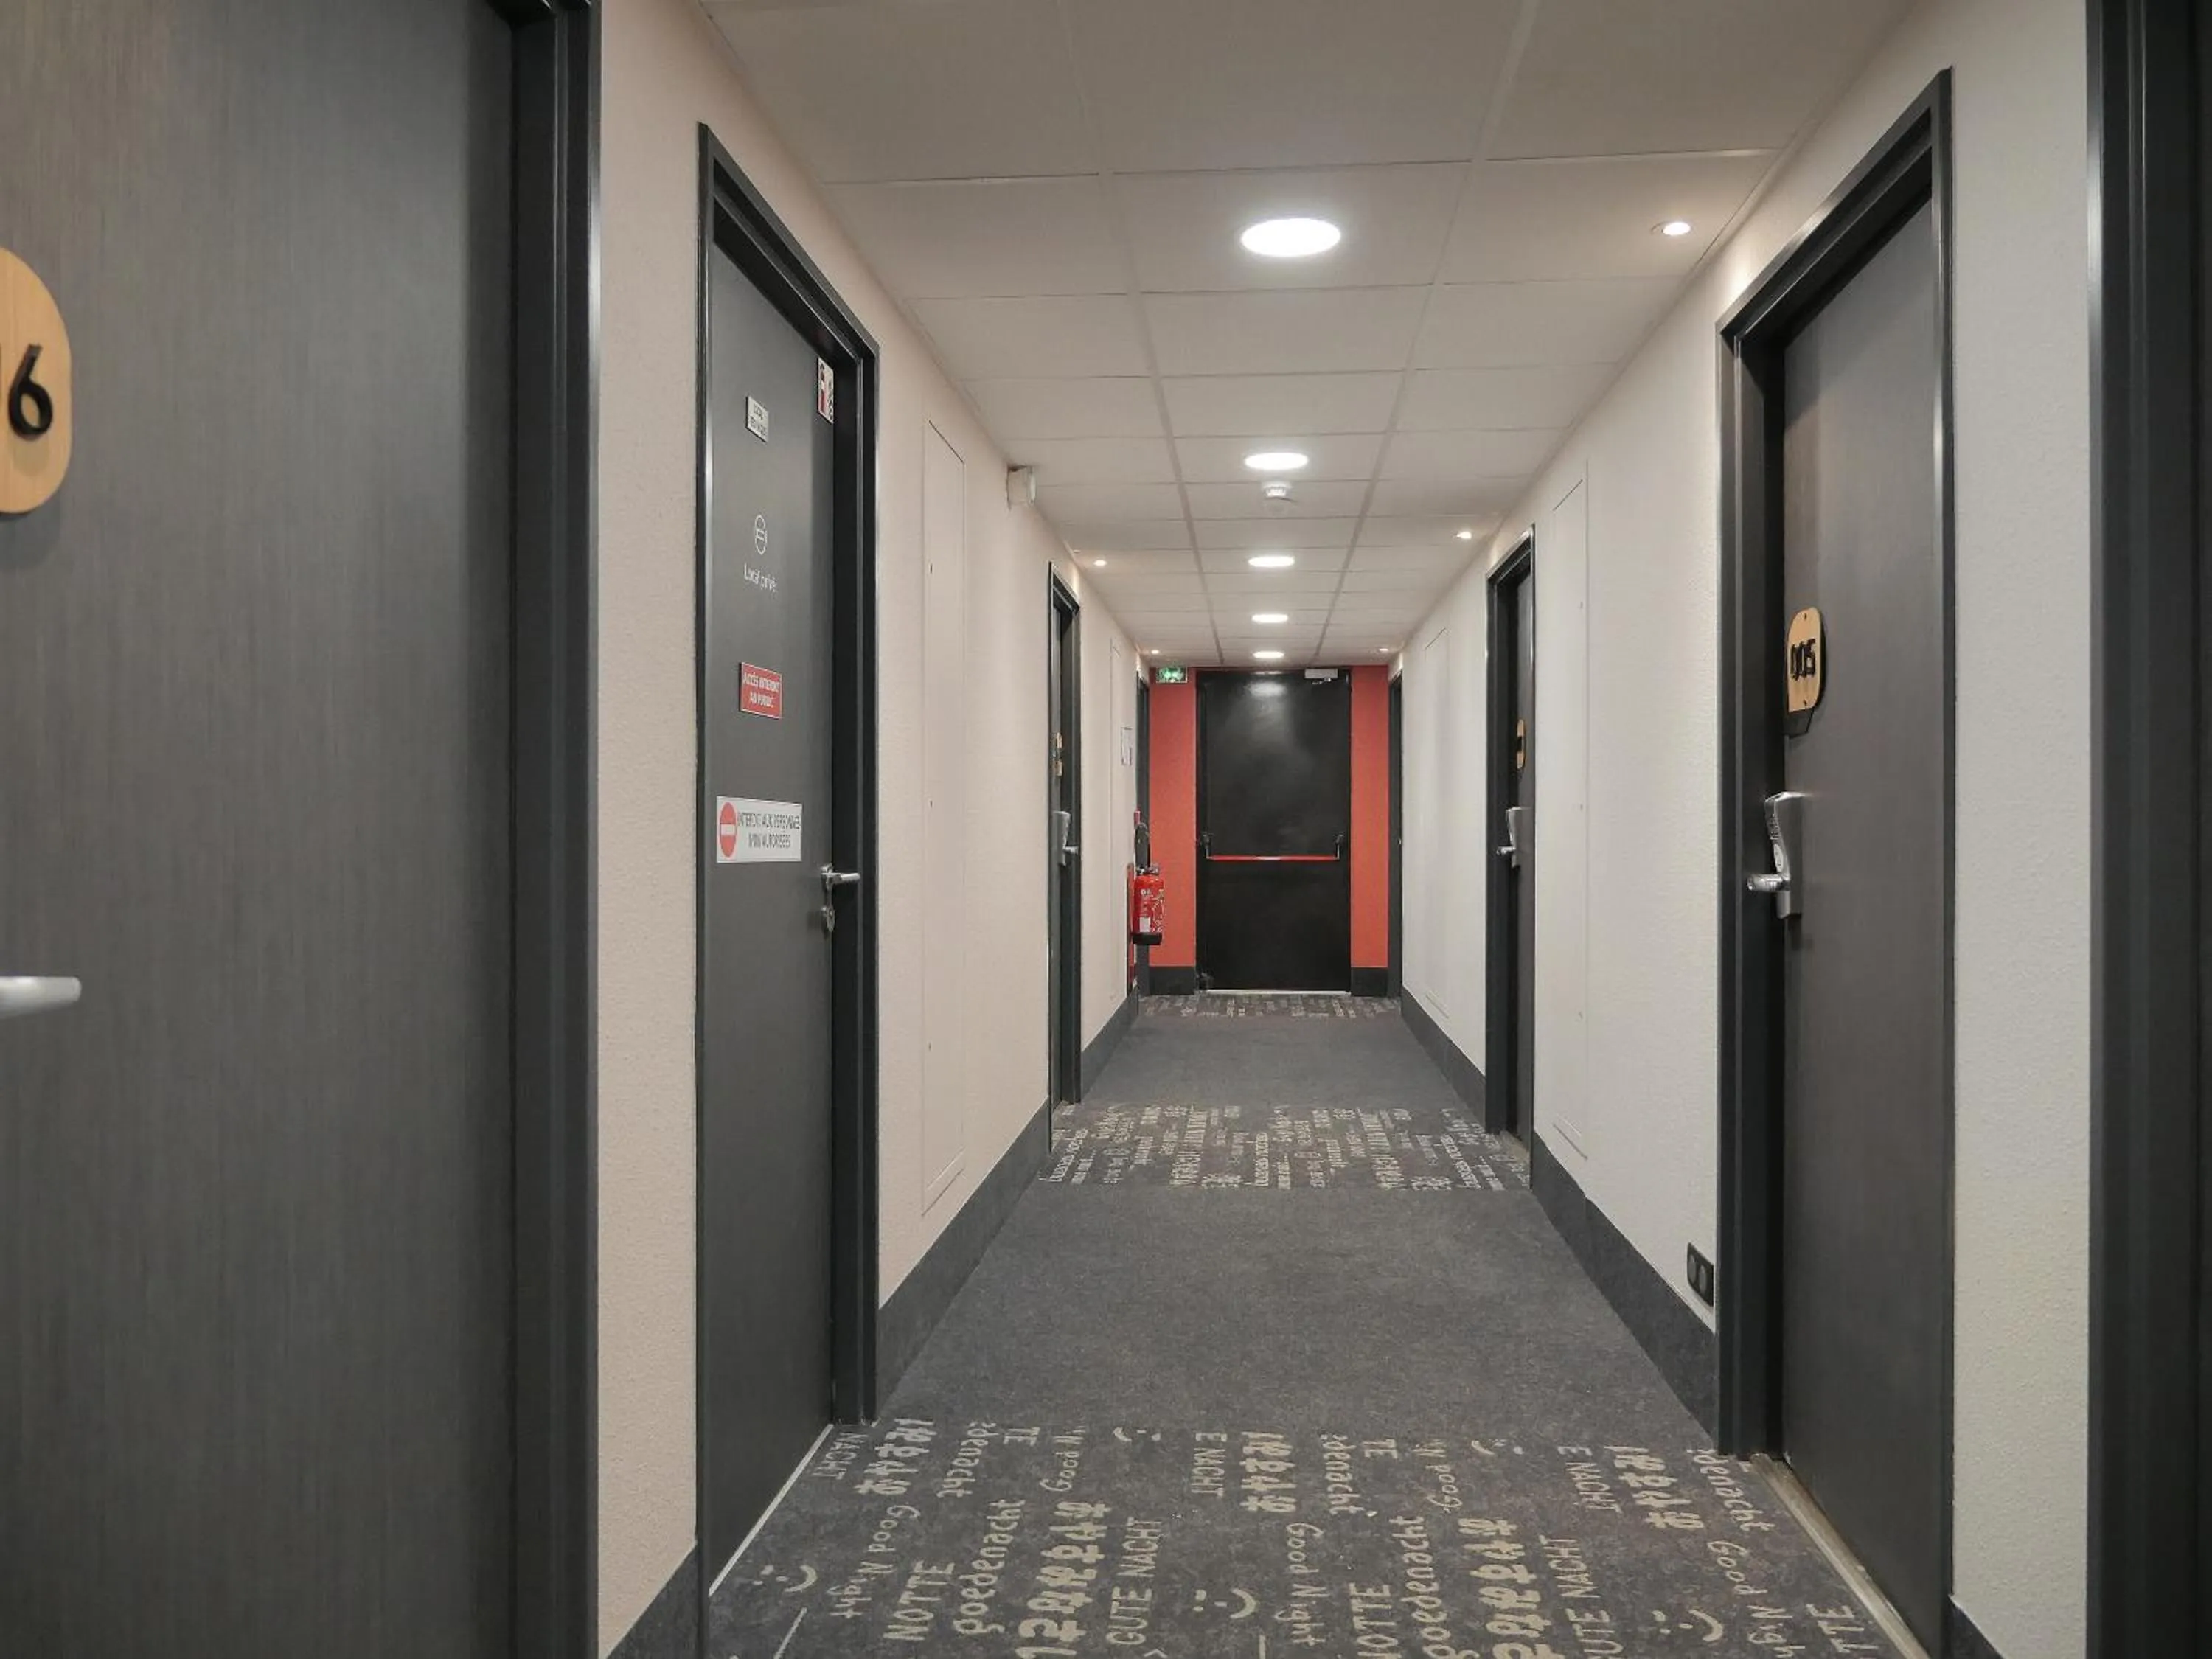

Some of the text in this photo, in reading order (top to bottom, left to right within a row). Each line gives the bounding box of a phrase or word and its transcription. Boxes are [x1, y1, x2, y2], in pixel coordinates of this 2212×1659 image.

[0, 343, 53, 441] 6
[813, 1431, 869, 1480] NACHT
[1039, 1450, 1081, 1492] Good
[1190, 1447, 1227, 1498] NACHT
[1425, 1464, 1463, 1509] Good
[1564, 1461, 1623, 1514] NACHT
[825, 1504, 921, 1620] Good Night
[883, 1559, 956, 1641] NOTTE
[953, 1500, 1026, 1635] goedenacht
[1106, 1516, 1164, 1646] GUTE NACHT
[1273, 1522, 1329, 1646] Good Night
[1538, 1534, 1623, 1659] UTE NACHT
[1707, 1540, 1768, 1595] Good
